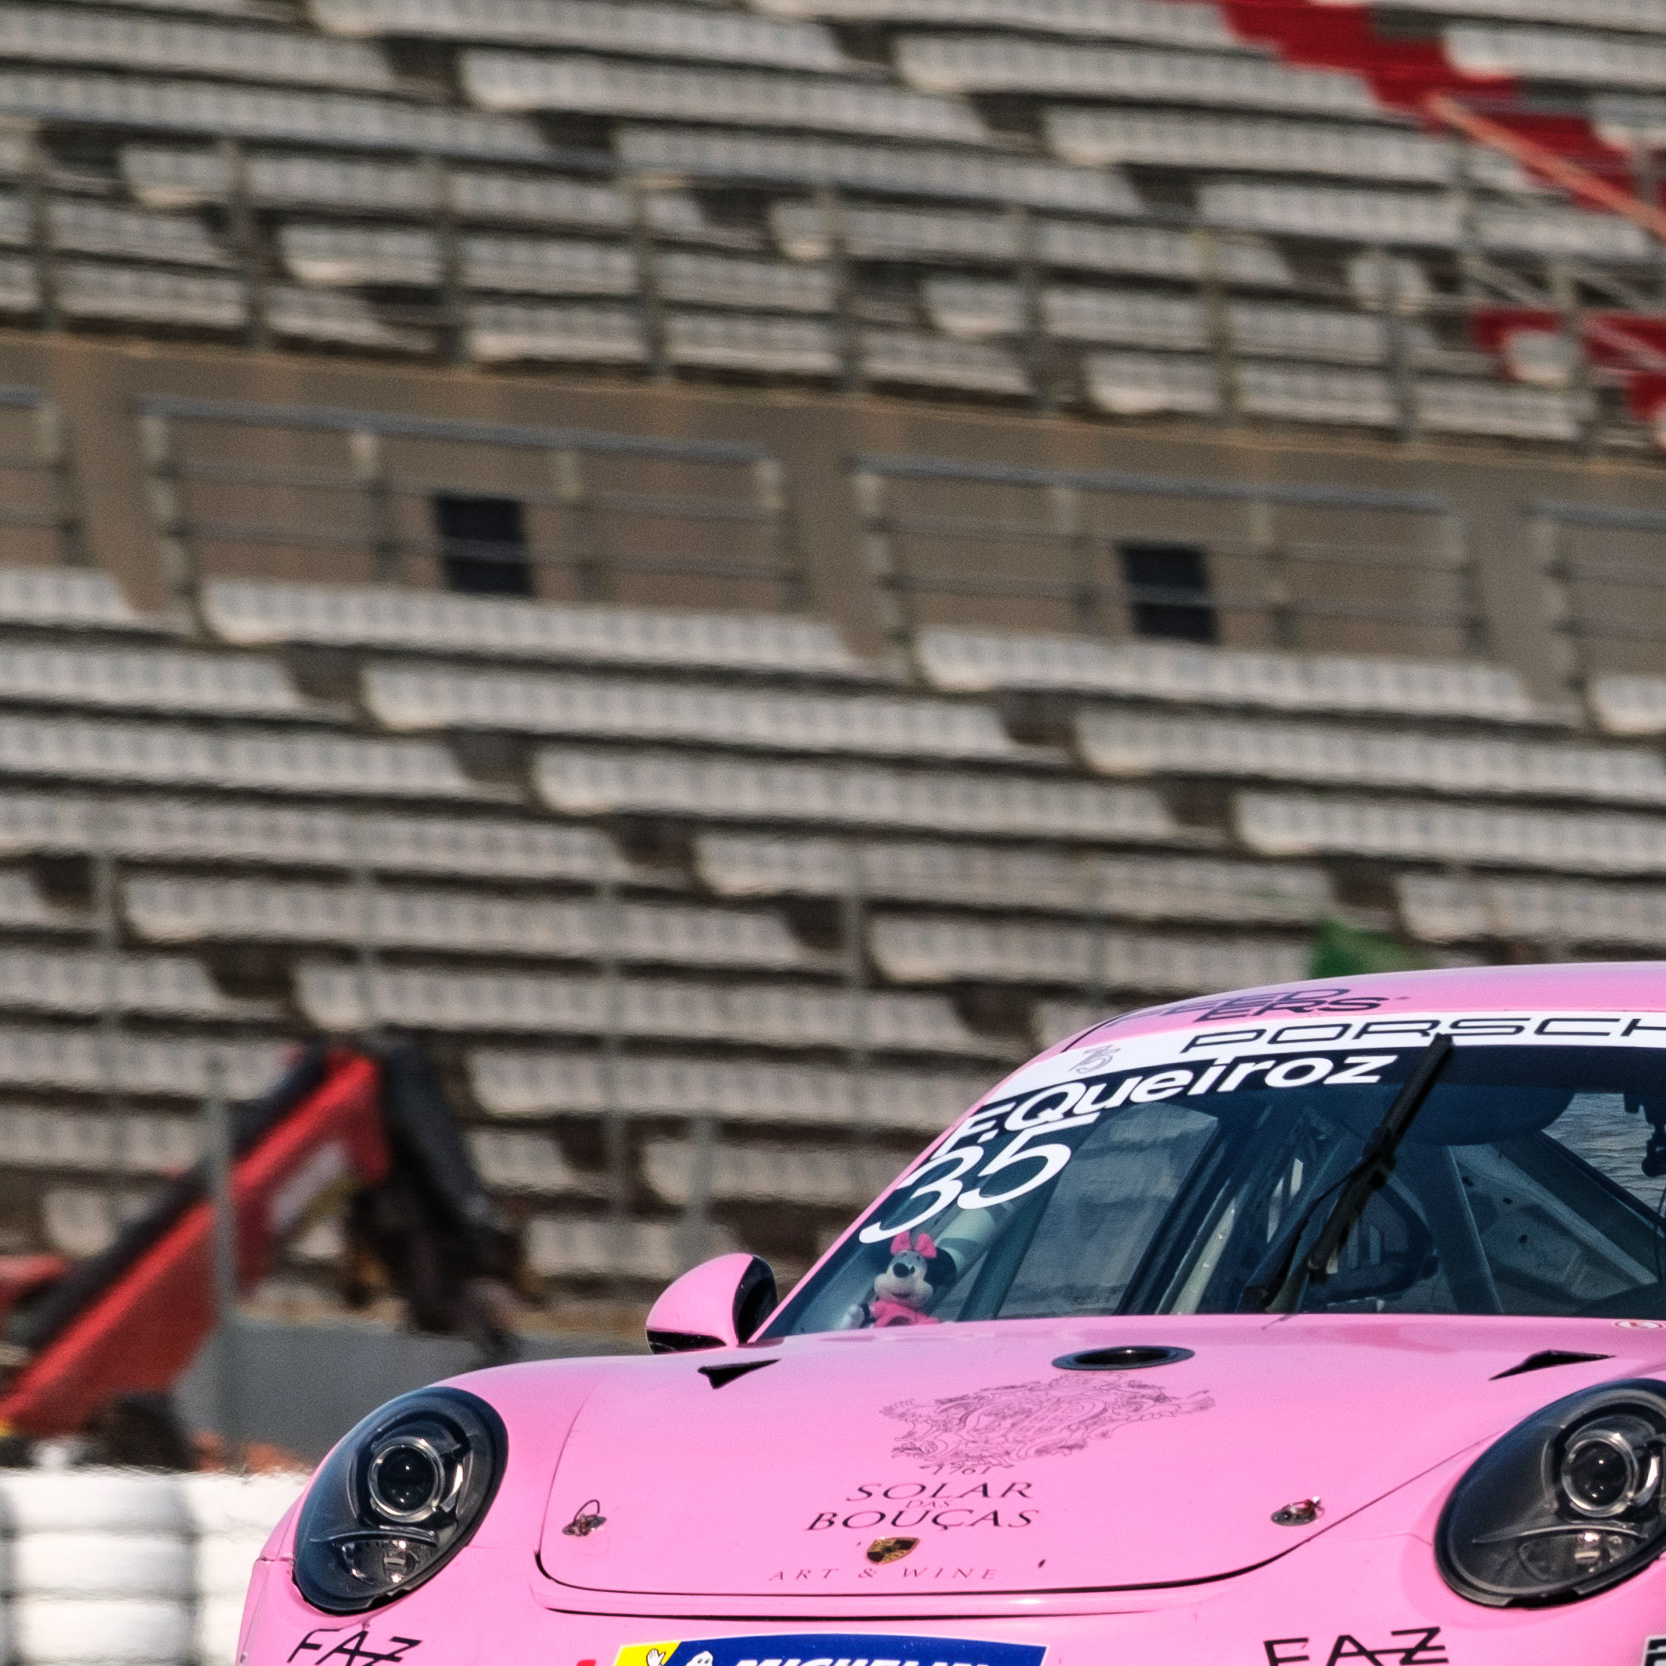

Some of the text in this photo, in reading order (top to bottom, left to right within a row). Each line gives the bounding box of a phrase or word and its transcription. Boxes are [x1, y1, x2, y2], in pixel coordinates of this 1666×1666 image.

[858, 1112, 1101, 1244] 35
[846, 1482, 1033, 1502] SOLAR
[805, 1509, 1039, 1531] BOUÇAS
[768, 1568, 839, 1582] ART
[902, 1567, 997, 1579] WINE
